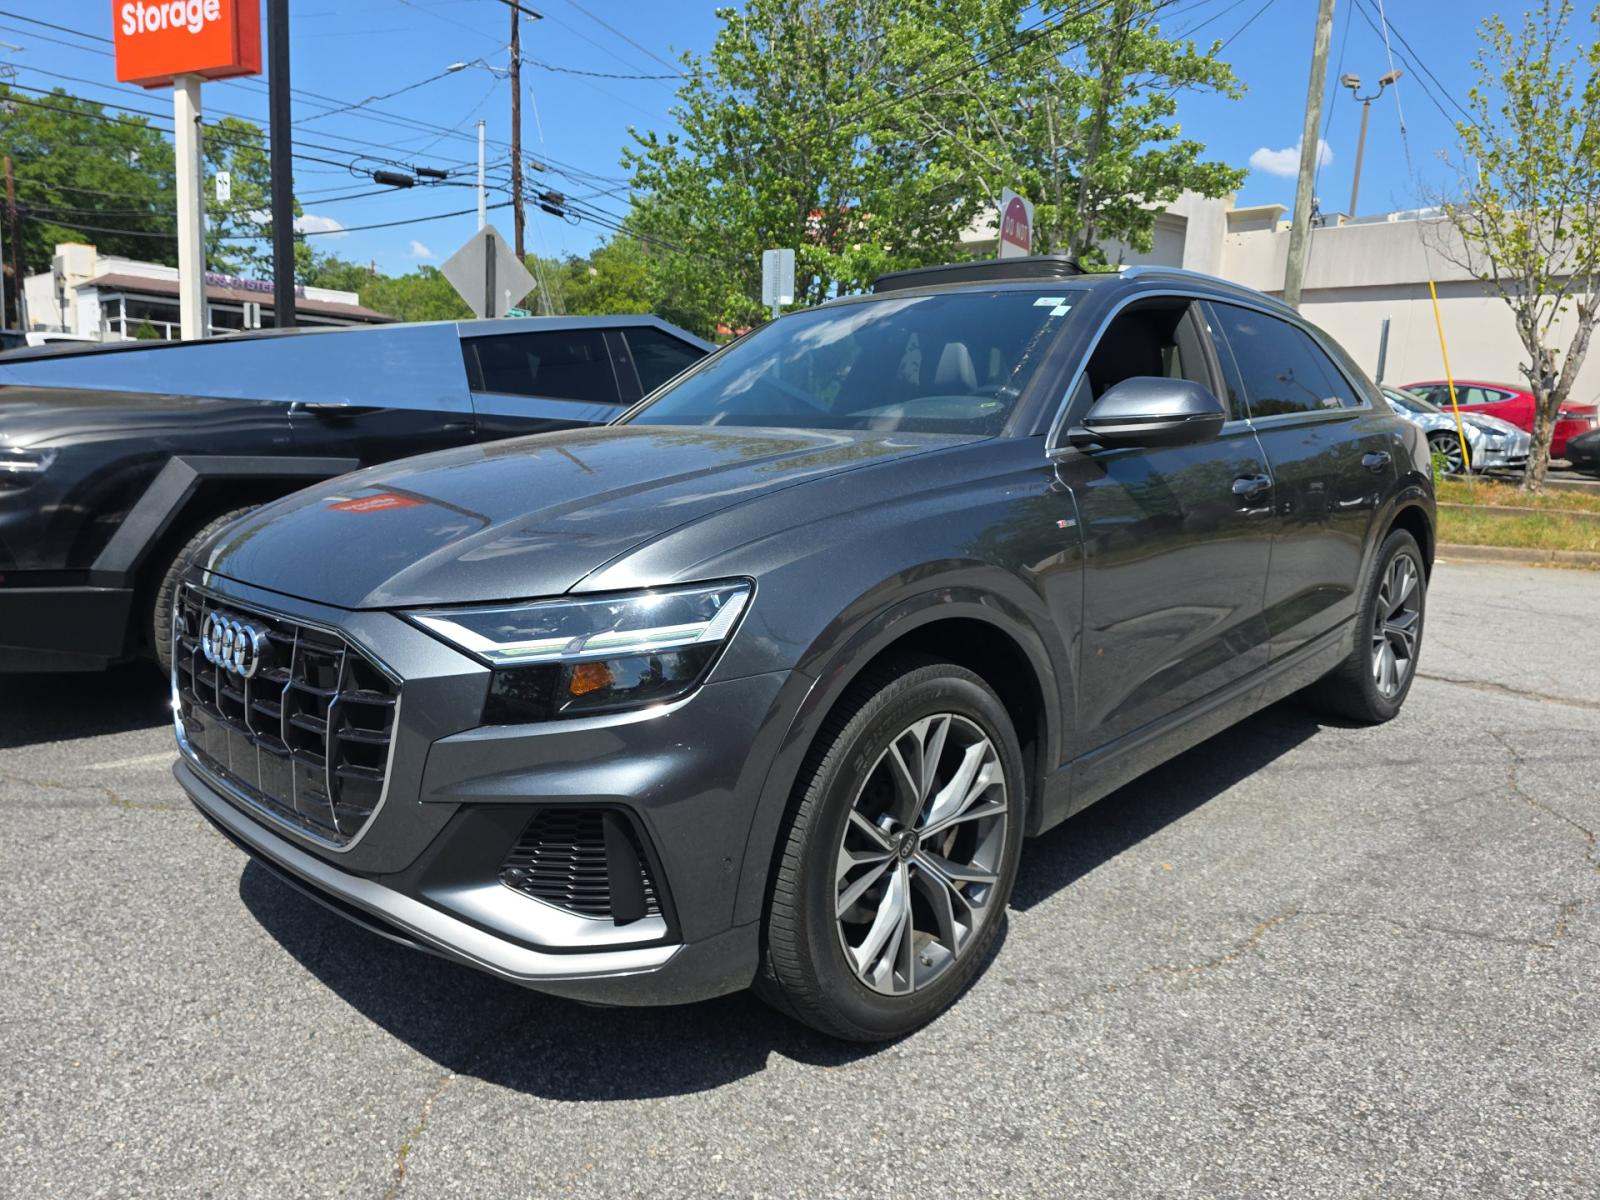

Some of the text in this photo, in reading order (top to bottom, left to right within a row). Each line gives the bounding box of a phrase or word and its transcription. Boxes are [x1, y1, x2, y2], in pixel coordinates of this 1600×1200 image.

[121, 0, 220, 36] Storage
[1005, 215, 1028, 242] DO NOT
